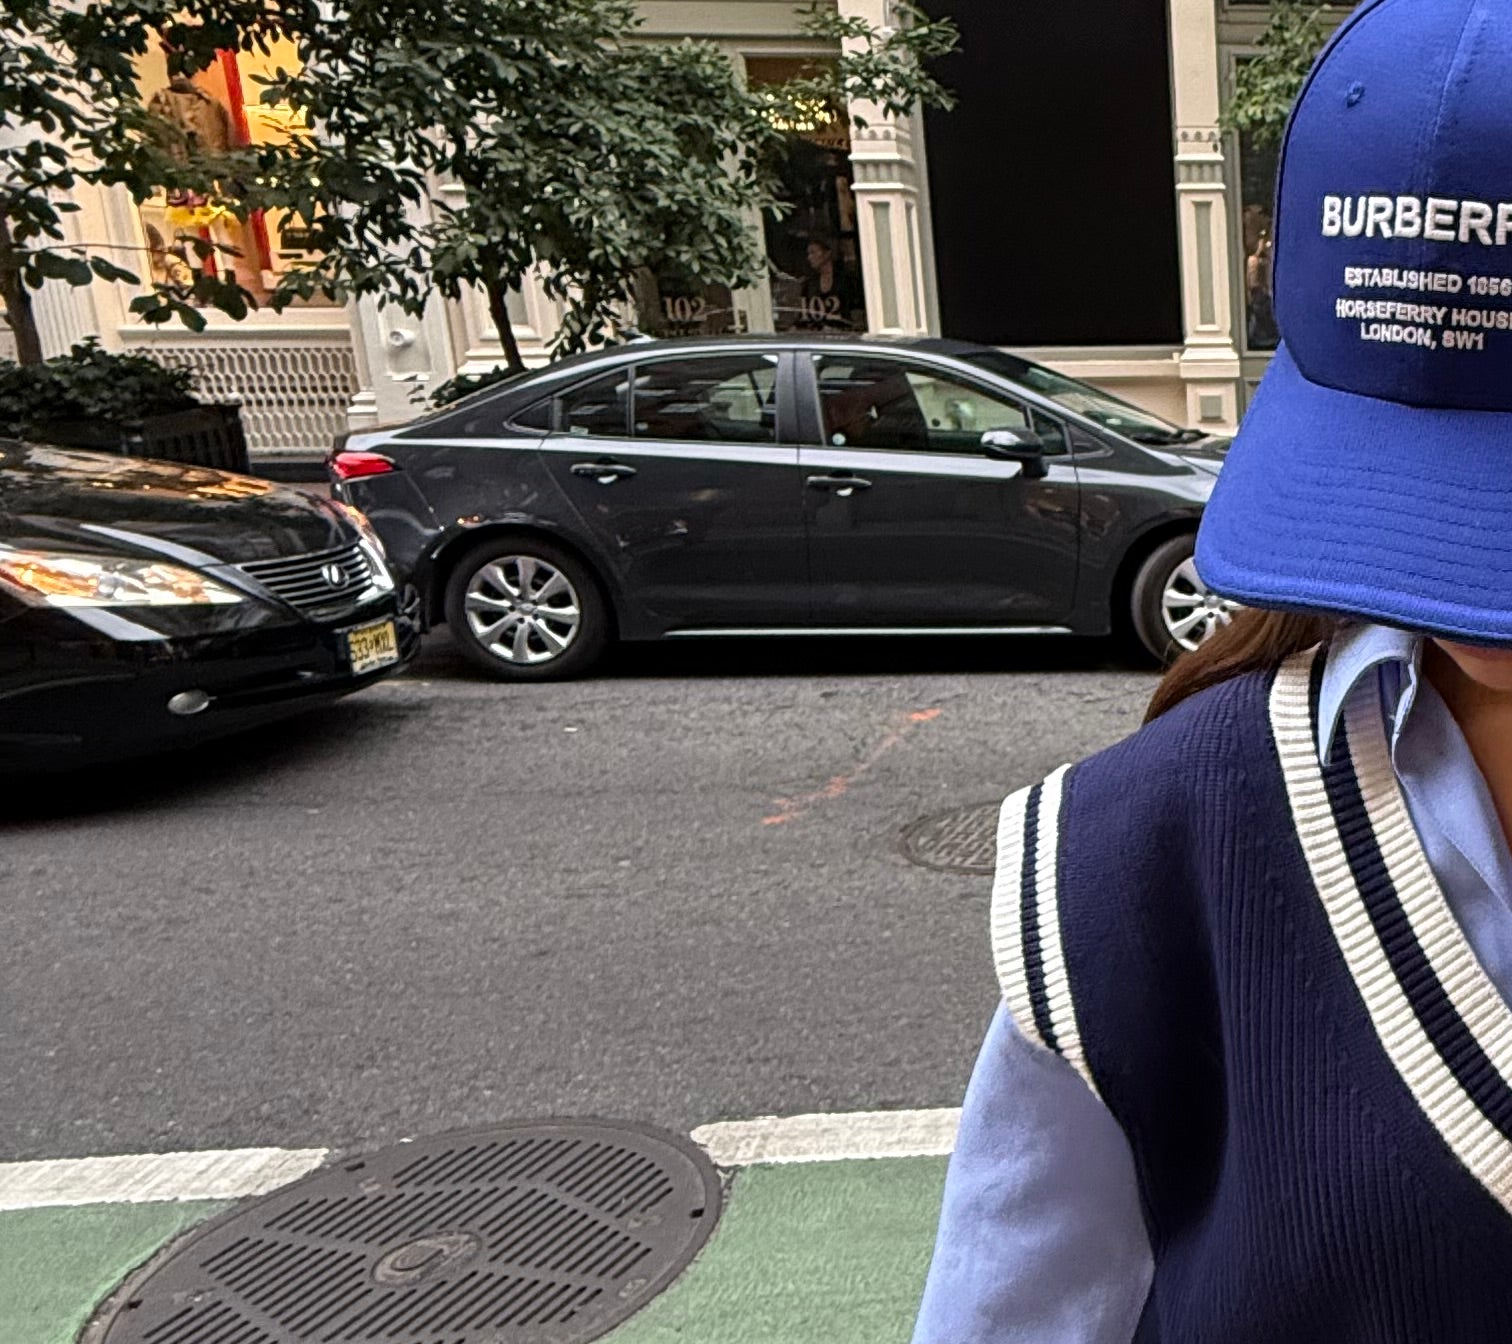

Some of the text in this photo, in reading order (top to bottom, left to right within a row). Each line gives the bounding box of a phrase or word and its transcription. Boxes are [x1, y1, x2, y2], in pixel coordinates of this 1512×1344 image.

[1344, 266, 1512, 296] ESTABLISHED 1856
[663, 295, 707, 321] 102
[1335, 297, 1448, 325] HORSEFERRY
[1360, 322, 1484, 350] LONDON, SW1
